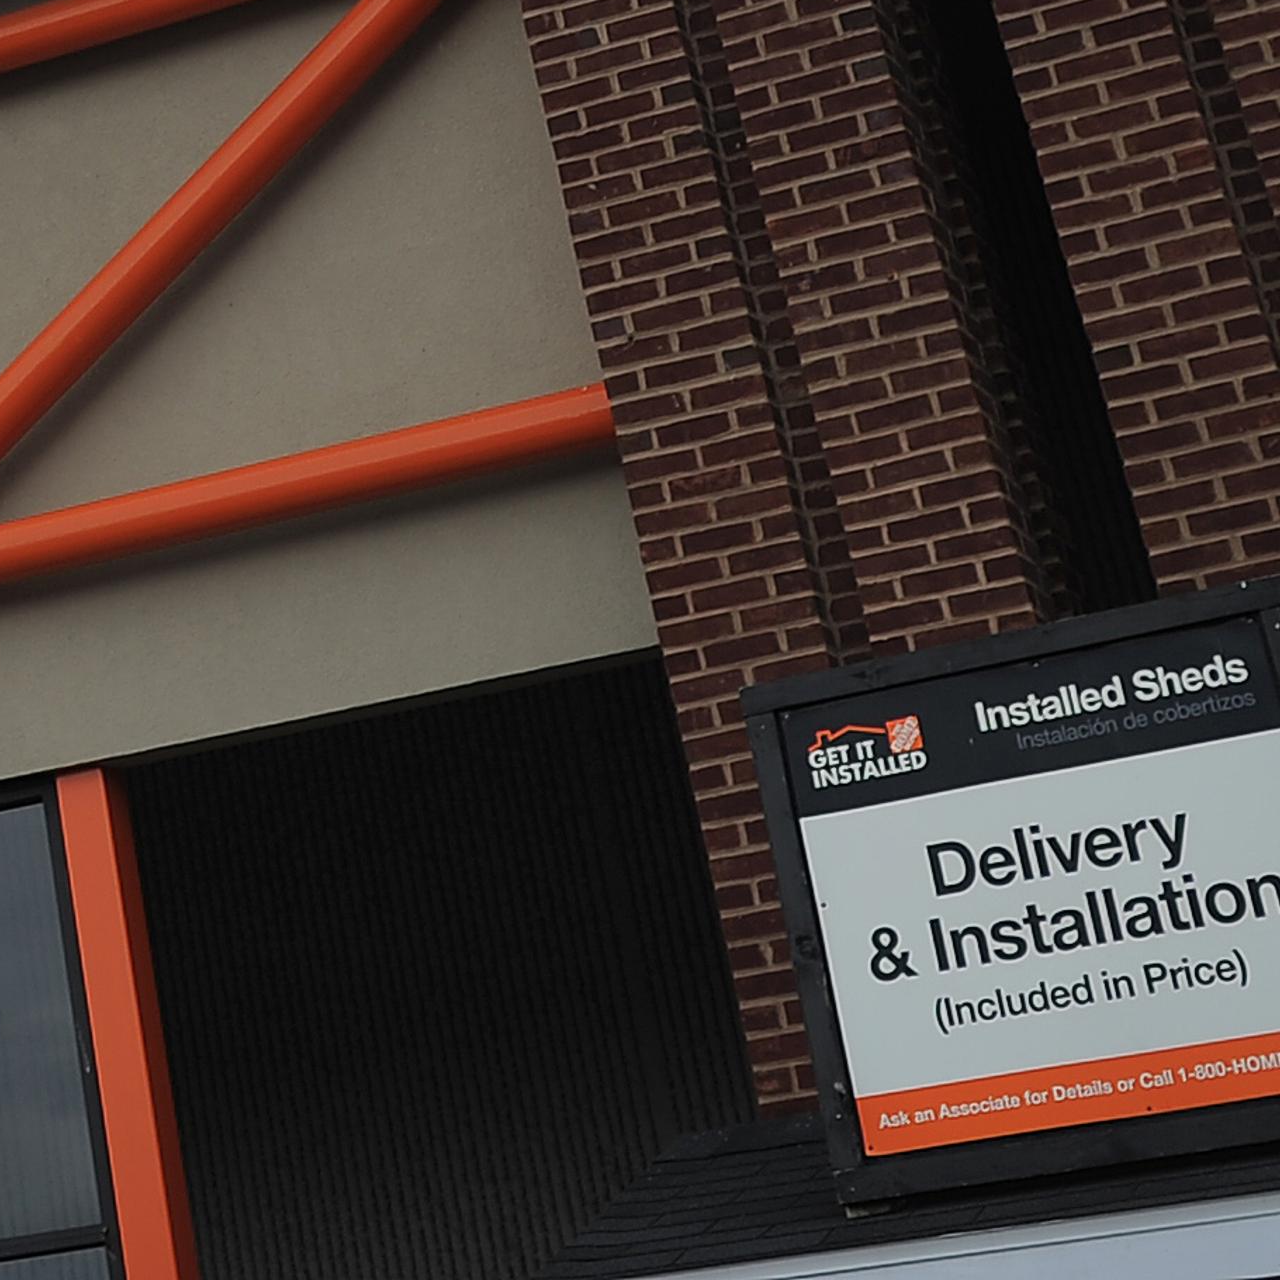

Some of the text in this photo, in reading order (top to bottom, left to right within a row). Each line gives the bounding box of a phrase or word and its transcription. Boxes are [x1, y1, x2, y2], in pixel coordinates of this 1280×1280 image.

[975, 654, 1249, 732] Installed Sheds
[1016, 692, 1257, 749] Instalación de cobertizos
[808, 739, 875, 769] GET IT
[811, 750, 928, 789] INSTALLED
[926, 812, 1187, 896] Delivery
[870, 926, 919, 982] &
[935, 948, 1248, 1035] (Included in Price)
[878, 1051, 1280, 1129] Ask an Associate for Details or Call 1-800-HOM
